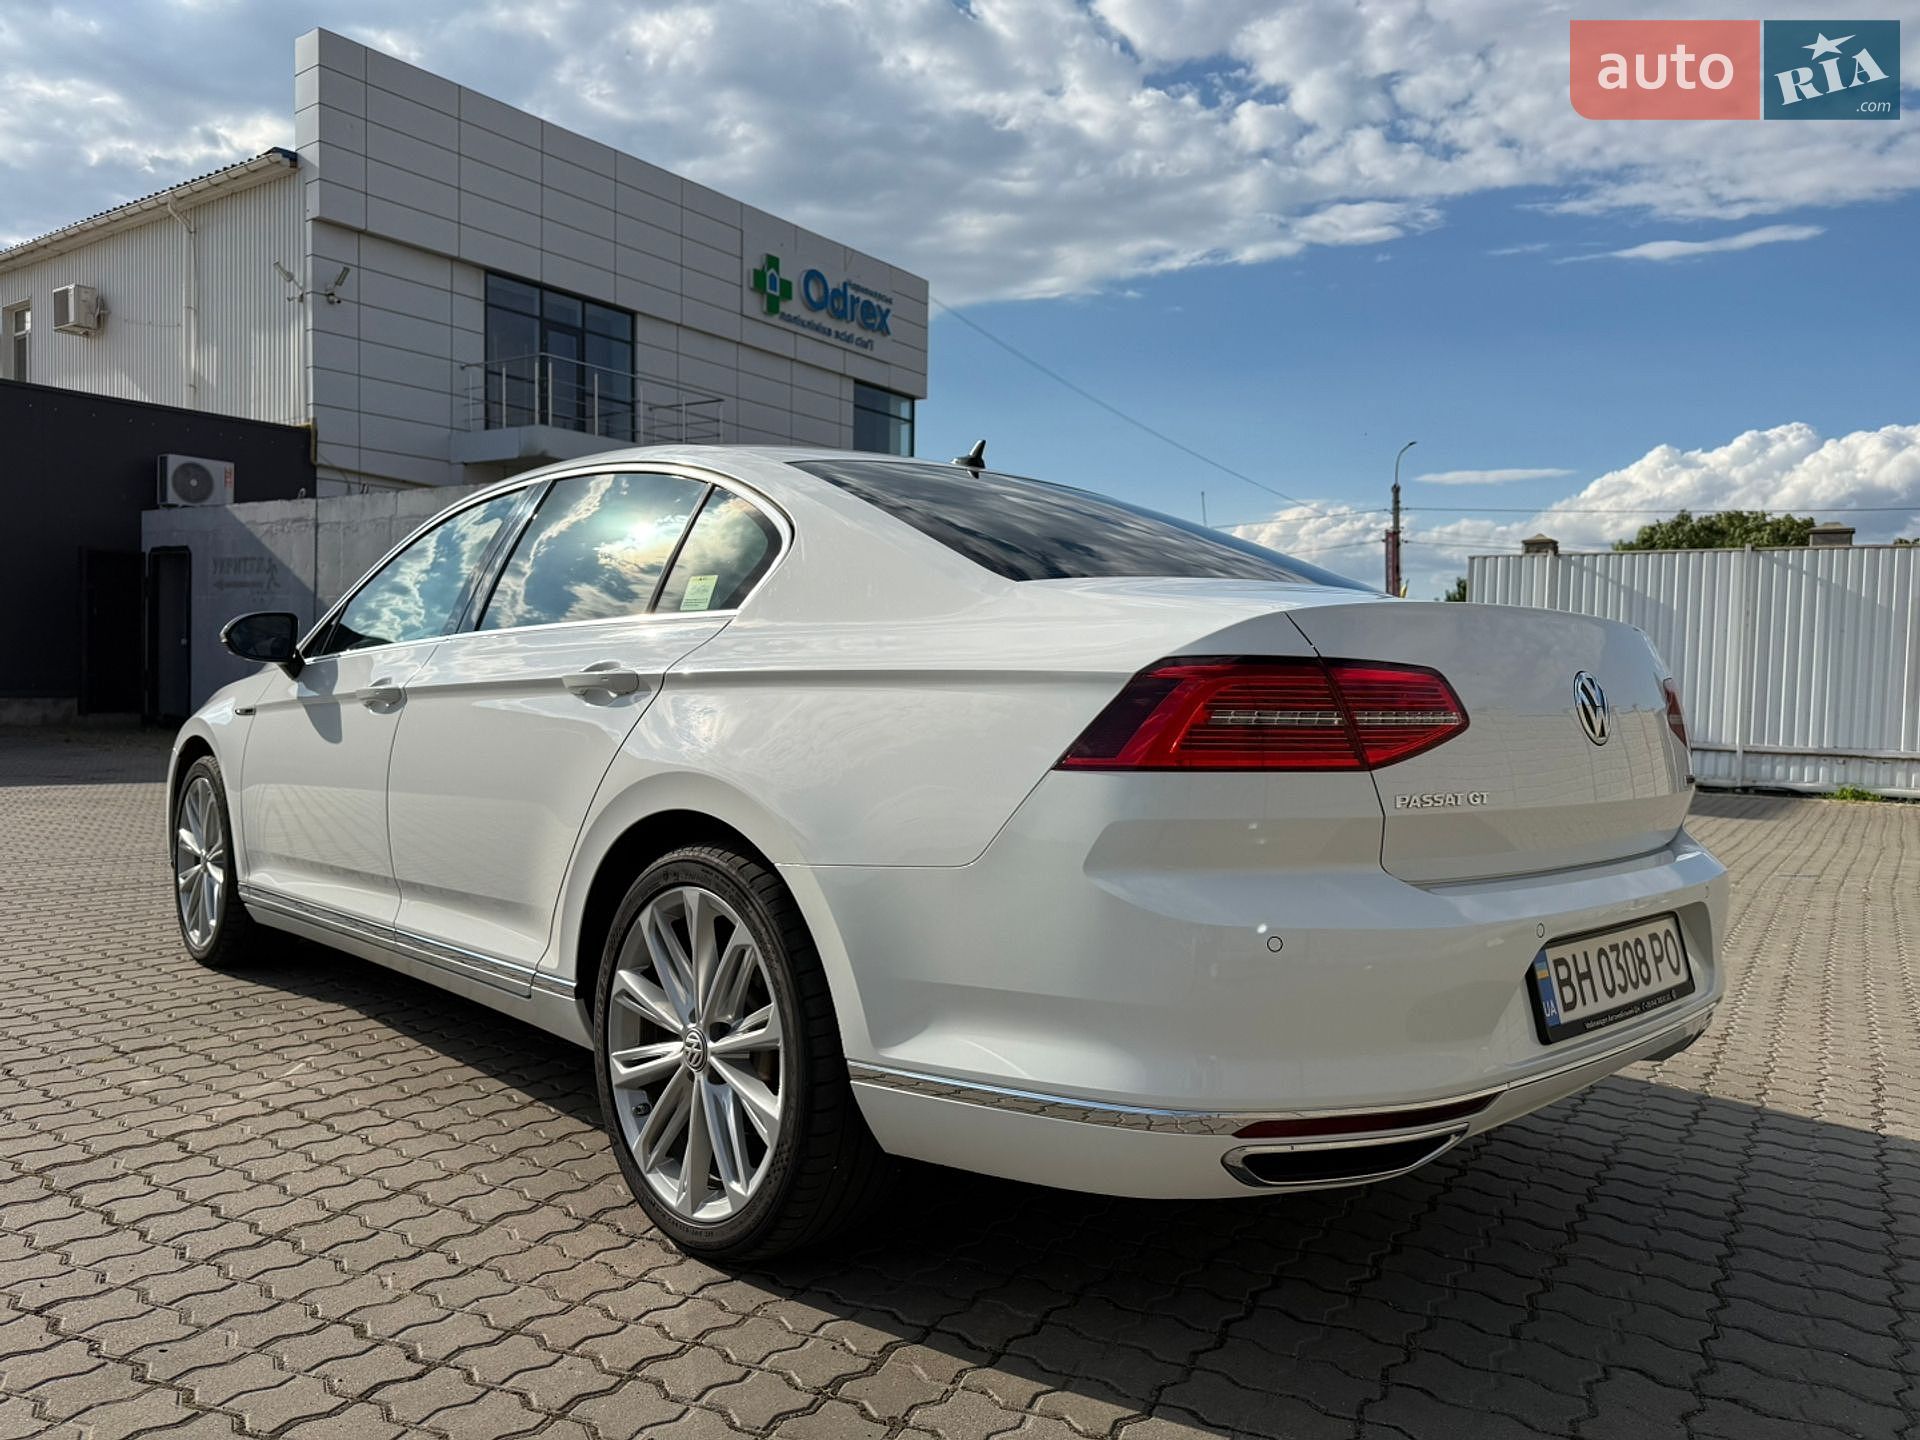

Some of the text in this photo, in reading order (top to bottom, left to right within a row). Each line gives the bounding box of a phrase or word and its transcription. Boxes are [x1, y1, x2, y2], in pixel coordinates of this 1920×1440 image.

[802, 268, 891, 336] Odrex
[1395, 791, 1489, 808] PASSAT GT
[1553, 928, 1681, 1013] BH 0308 PO
[1543, 1001, 1557, 1017] UA
